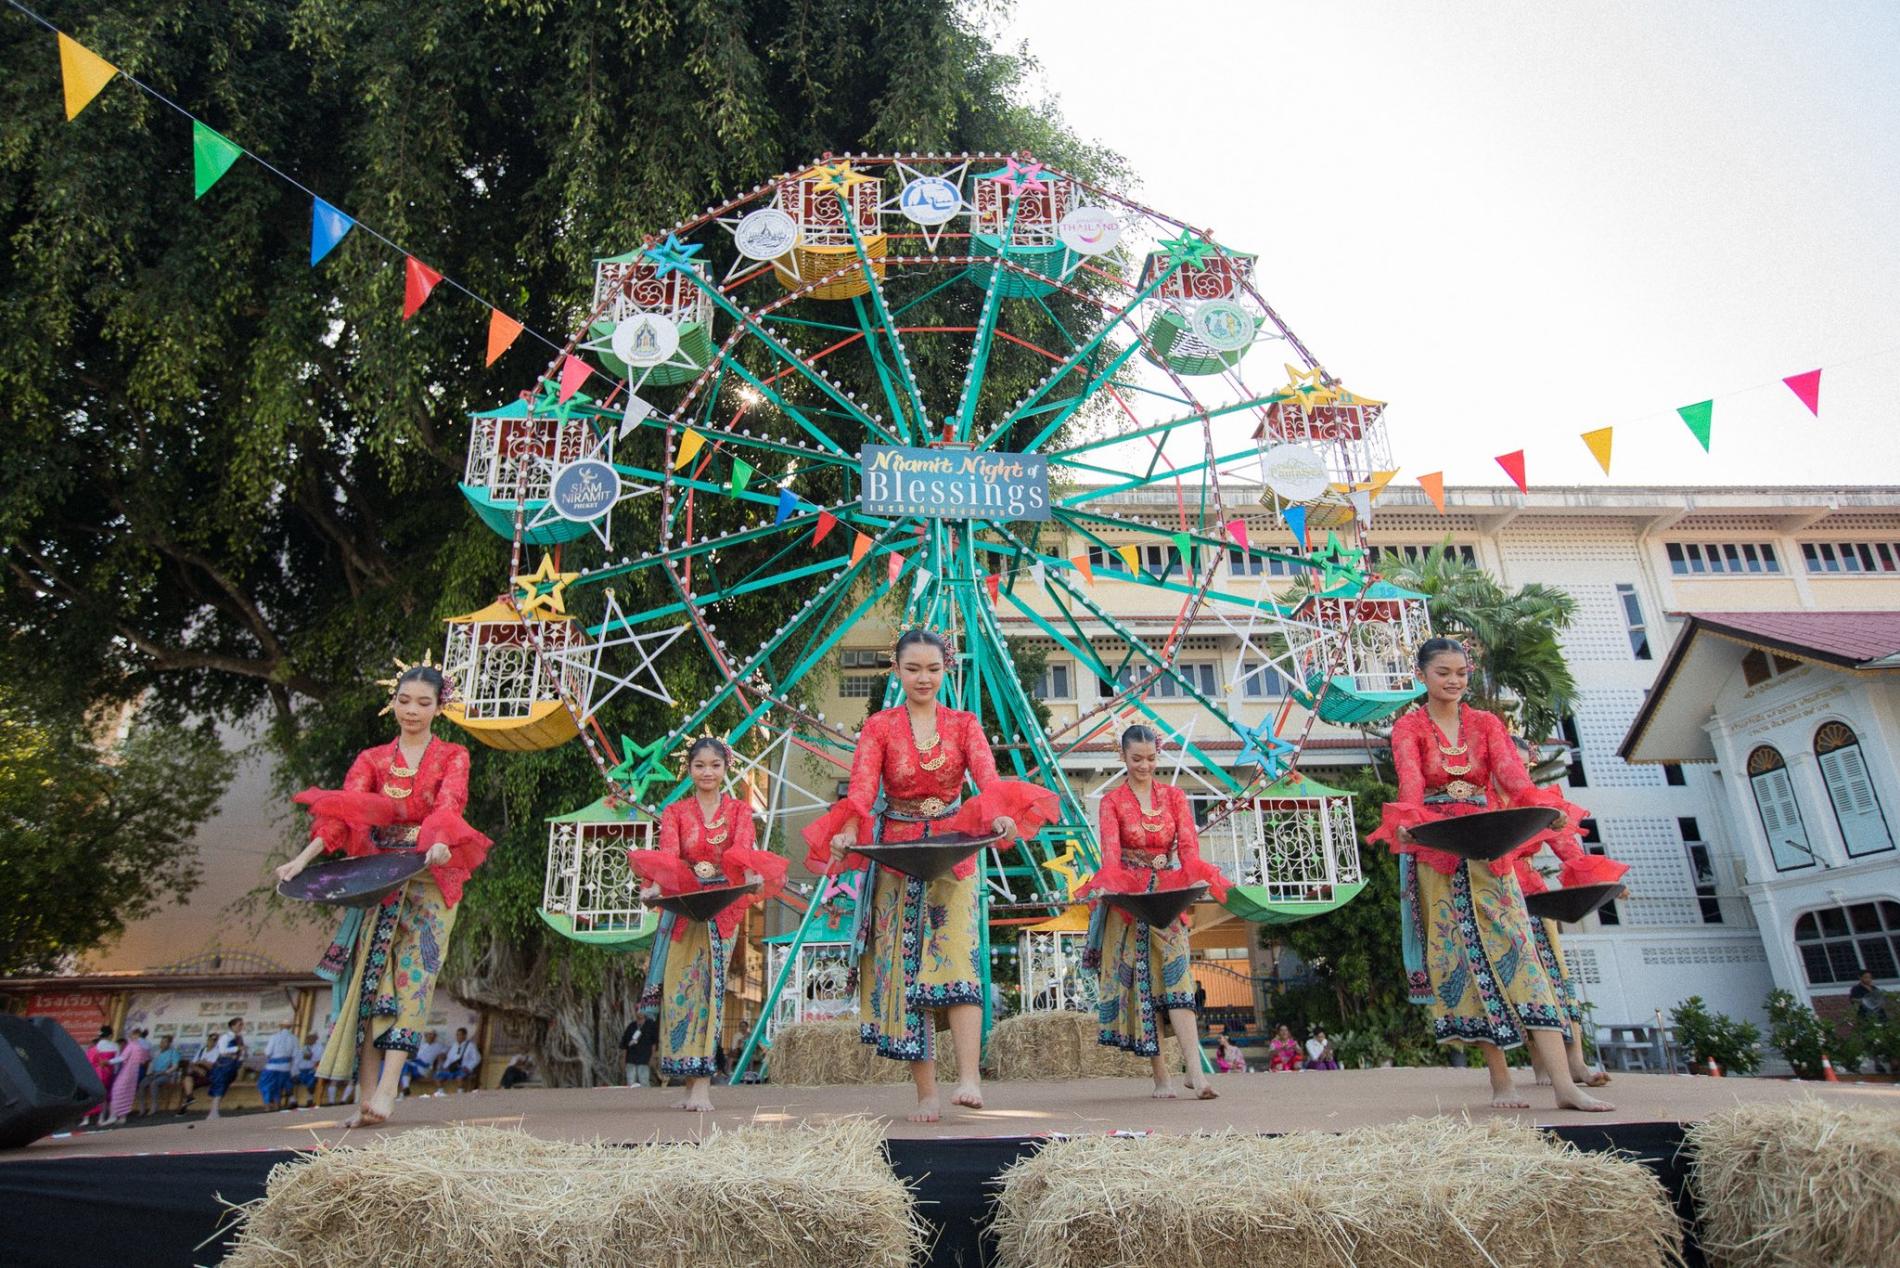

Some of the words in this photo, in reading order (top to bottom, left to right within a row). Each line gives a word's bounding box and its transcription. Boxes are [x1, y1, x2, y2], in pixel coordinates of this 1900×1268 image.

[1062, 223, 1119, 232] THAILAND
[868, 450, 953, 473] Niramit
[957, 455, 1023, 483] Night
[1028, 464, 1041, 480] of
[570, 481, 603, 494] SIAM
[868, 472, 1044, 516] Blessings
[562, 490, 612, 505] NIRAMIT
